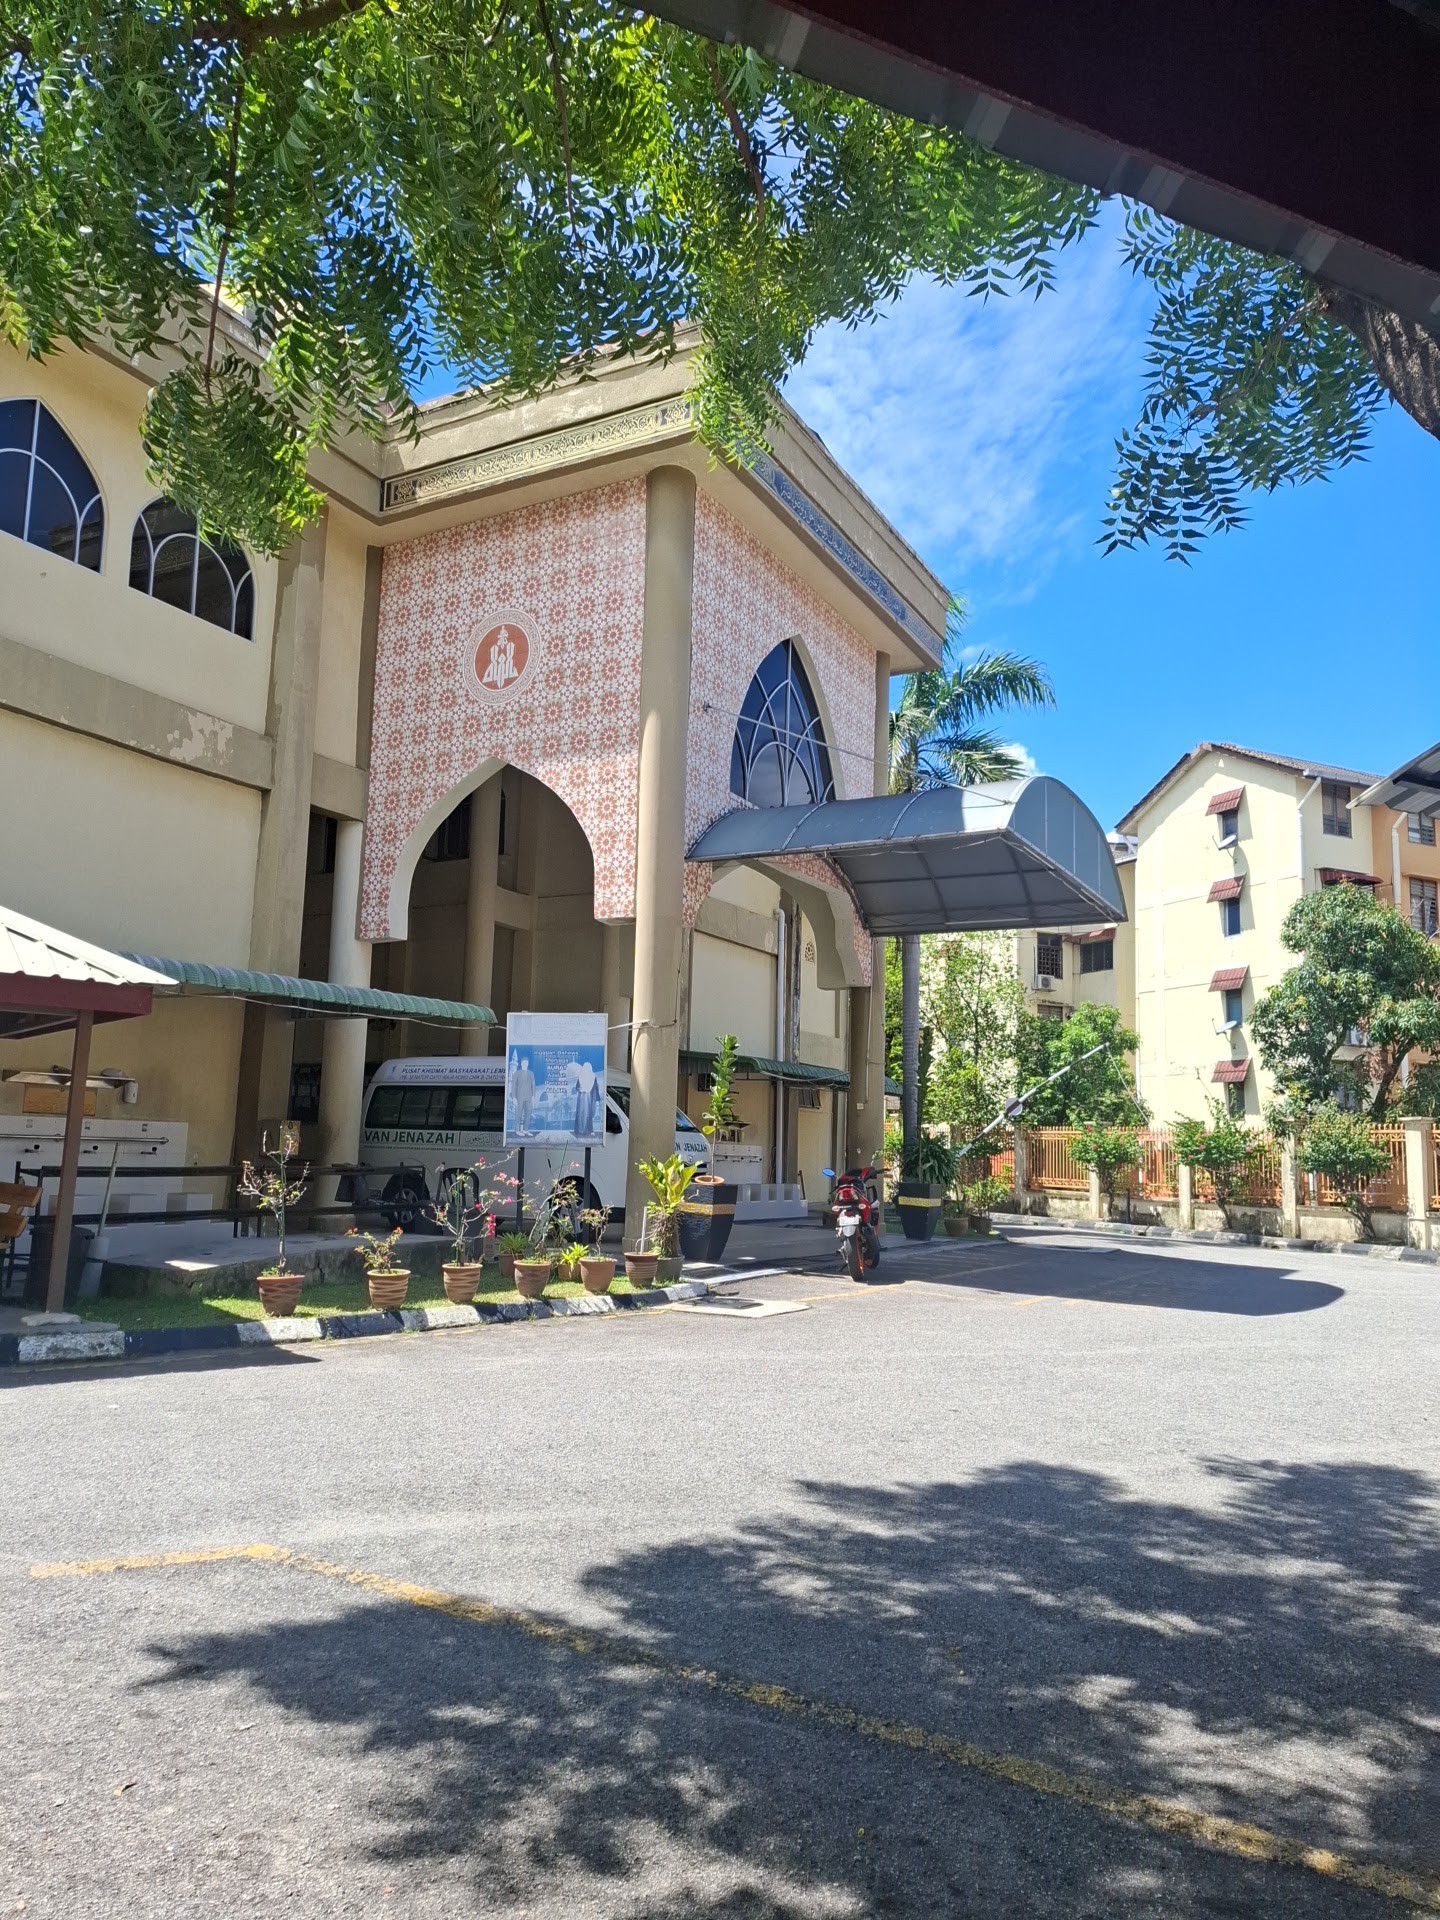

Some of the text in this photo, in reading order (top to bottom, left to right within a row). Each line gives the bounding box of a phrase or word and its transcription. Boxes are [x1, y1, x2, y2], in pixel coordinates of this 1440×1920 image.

[364, 1130, 390, 1142] VAN
[393, 1131, 455, 1144] JENAZAH
[684, 1143, 707, 1152] JENAZAH
